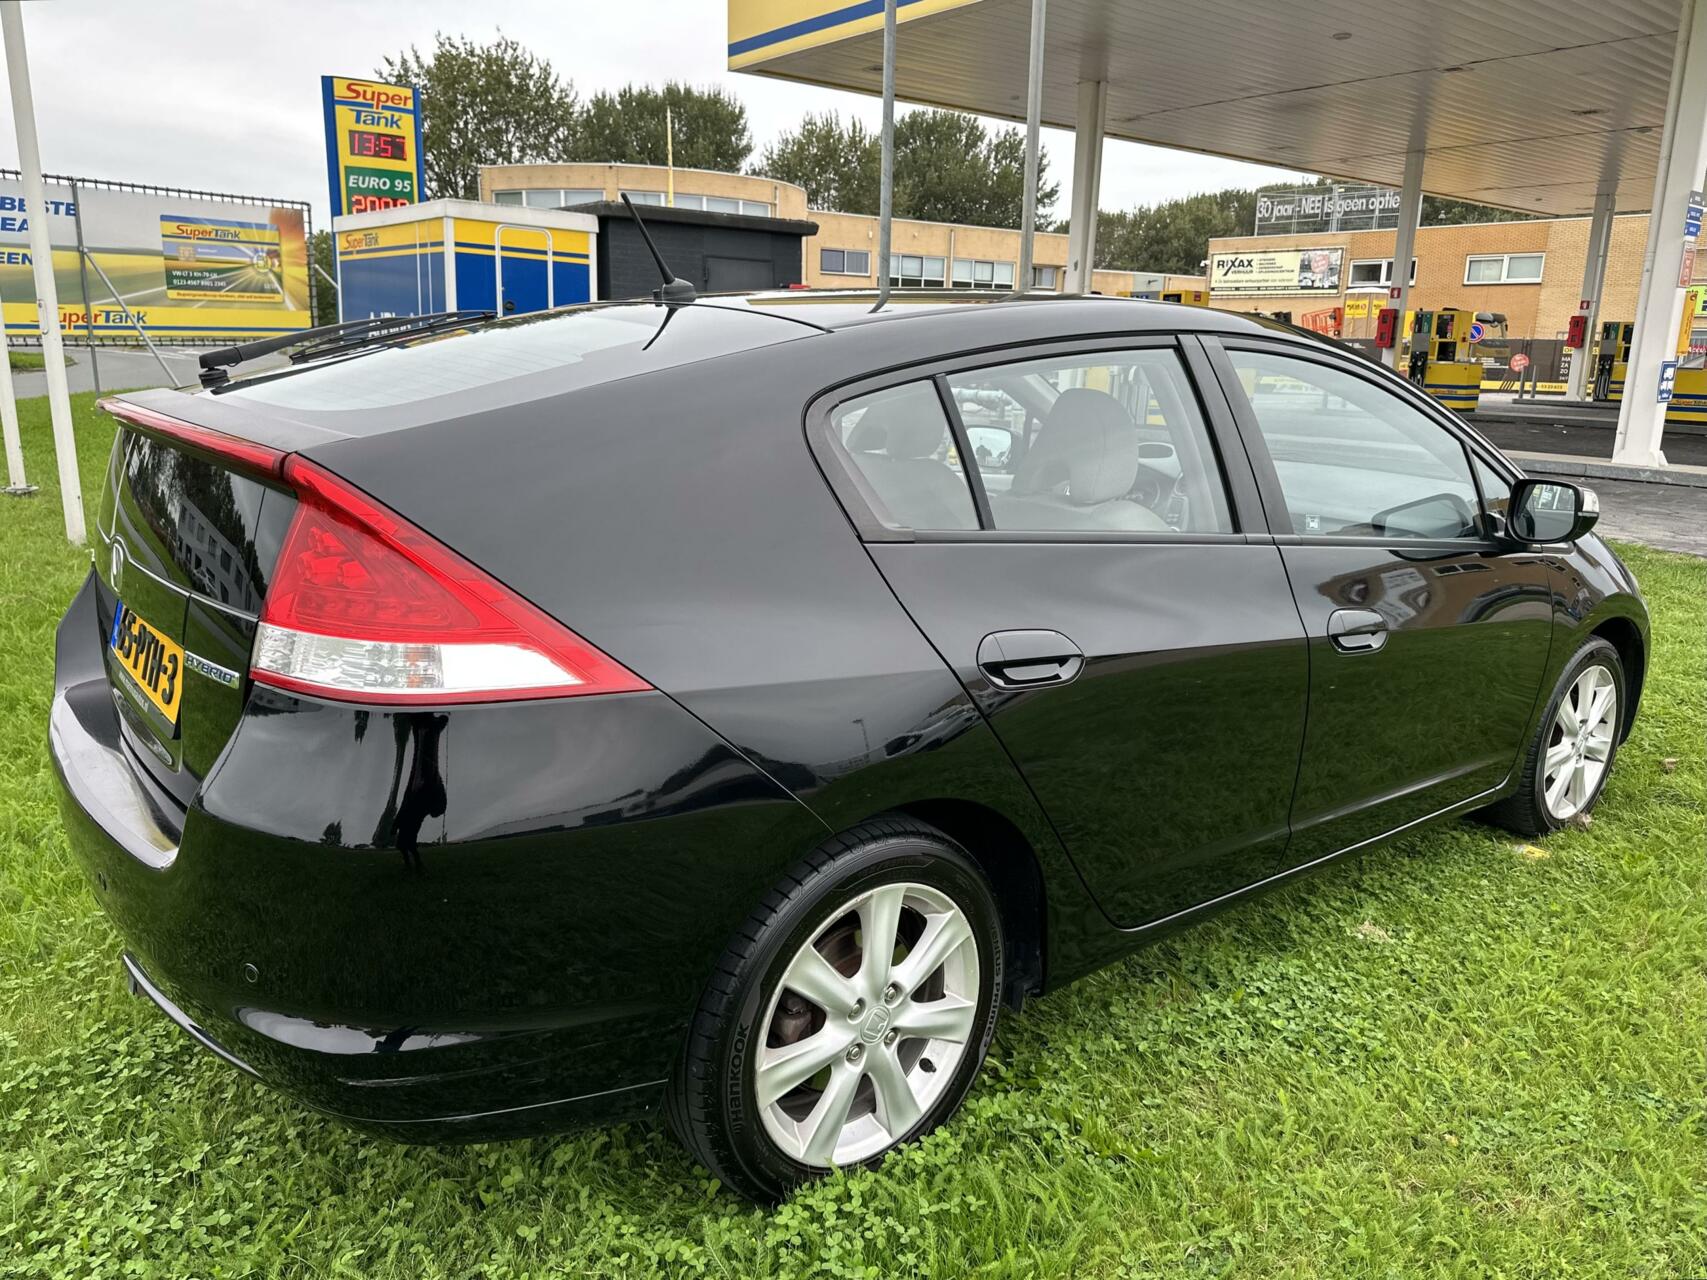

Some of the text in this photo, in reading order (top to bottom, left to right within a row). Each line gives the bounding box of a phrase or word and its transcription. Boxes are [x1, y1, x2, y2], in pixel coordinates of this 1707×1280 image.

[335, 82, 411, 110] Super
[347, 108, 402, 129] Tank
[353, 133, 407, 159] 13:57
[348, 175, 412, 192] EURO 95
[1258, 201, 1271, 217] 30
[1271, 202, 1295, 222] jaar
[1301, 197, 1322, 214] NEE
[1336, 198, 1366, 217] geen
[1368, 192, 1400, 209] optie
[173, 224, 240, 240] SuperTank
[1217, 257, 1254, 276] RIXAX
[31, 306, 149, 330] uperTank
[186, 653, 233, 684] HYBRID
